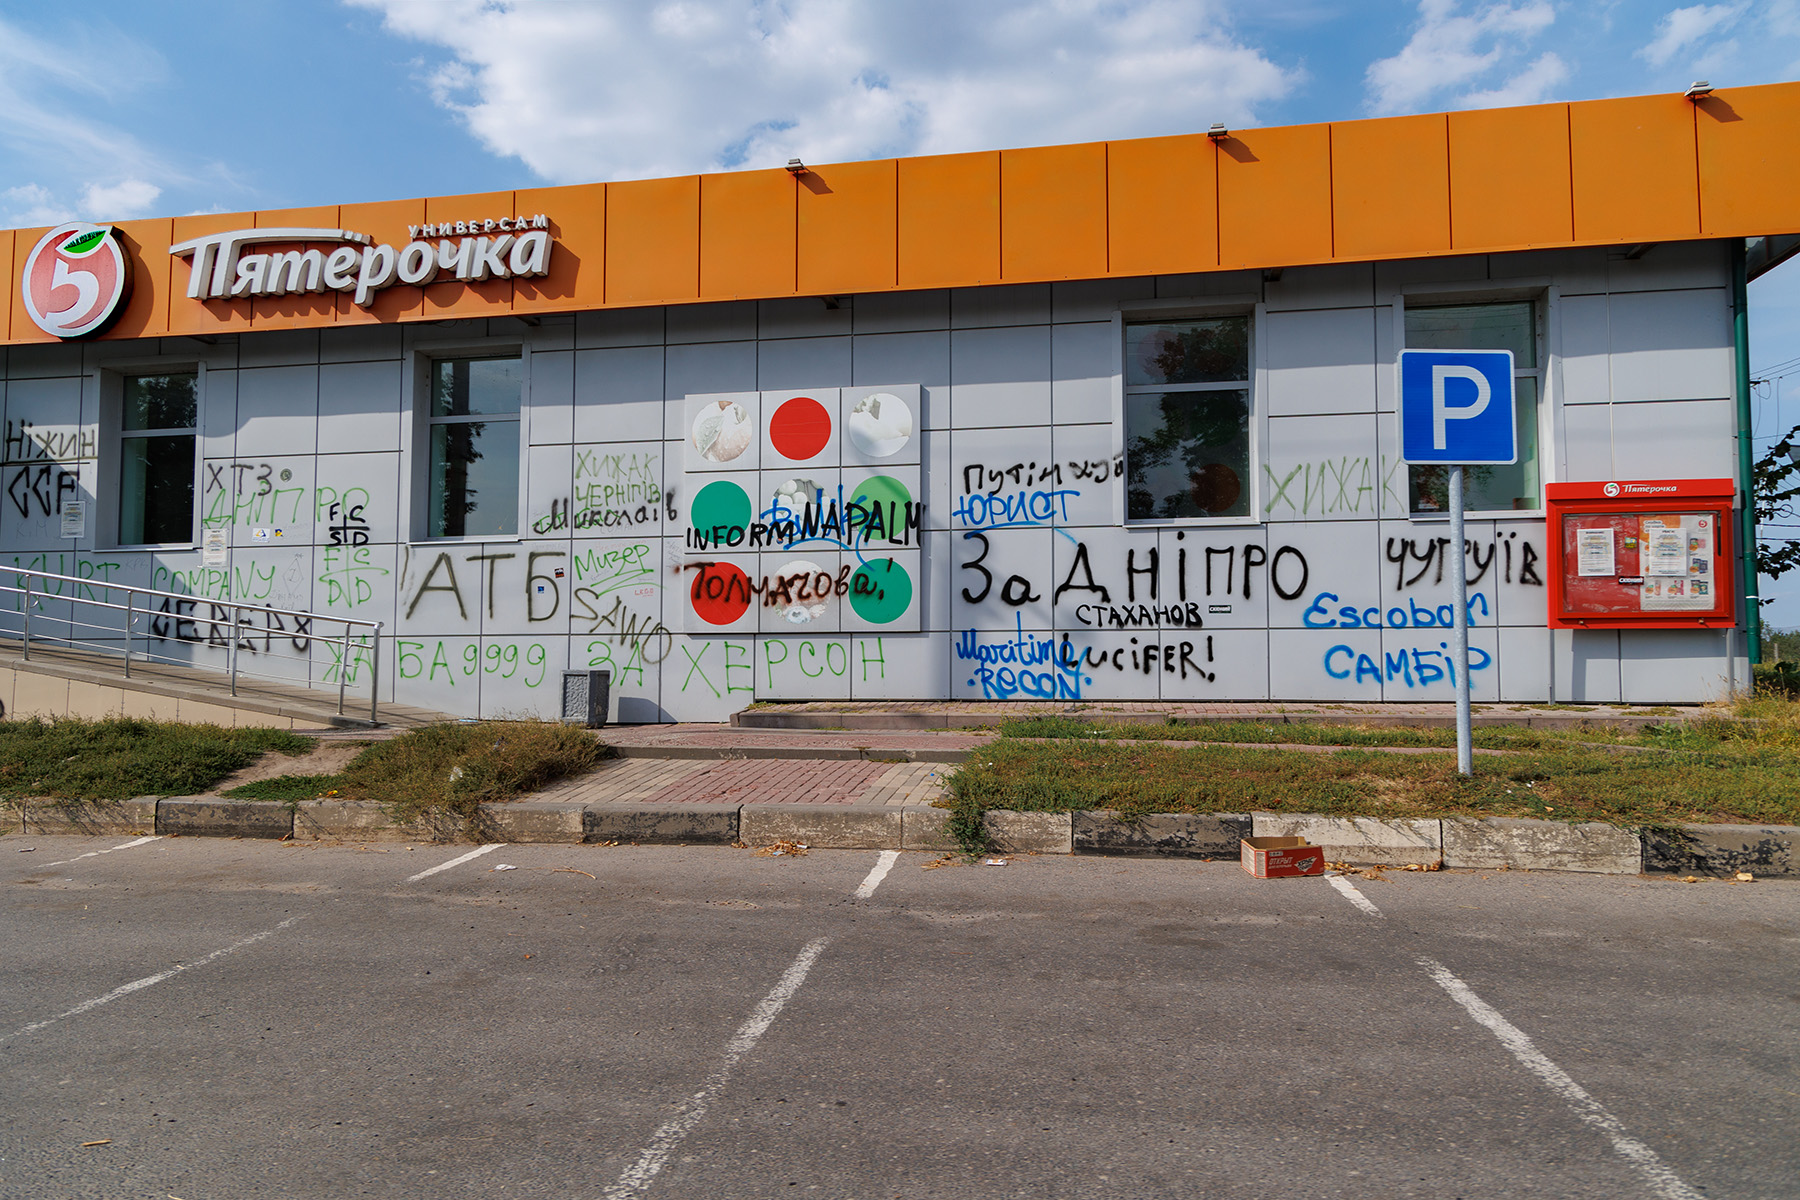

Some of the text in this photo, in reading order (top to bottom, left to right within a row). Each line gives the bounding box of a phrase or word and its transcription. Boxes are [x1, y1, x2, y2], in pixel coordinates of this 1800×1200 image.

[408, 215, 550, 239] УНИВЕРСАМ
[1432, 364, 1491, 450] P
[575, 449, 658, 483] ХИЖАК
[1263, 454, 1405, 515] ХИЖАК
[686, 522, 794, 551] INFORM
[800, 500, 925, 547] NAPALM
[952, 490, 1080, 526] ЮРИСТ
[14, 554, 120, 611] KURT
[153, 561, 276, 600] COMPANY
[406, 551, 566, 623] АТБ
[962, 531, 1309, 605] За ДНІПРО
[1075, 602, 1203, 629] СТАХАНОВ
[1303, 592, 1488, 629] Escobar
[587, 641, 643, 687] ЗА
[681, 637, 885, 698] ХЕРСОН
[956, 611, 1080, 674] Maritime
[1324, 641, 1491, 689] САМБІР
